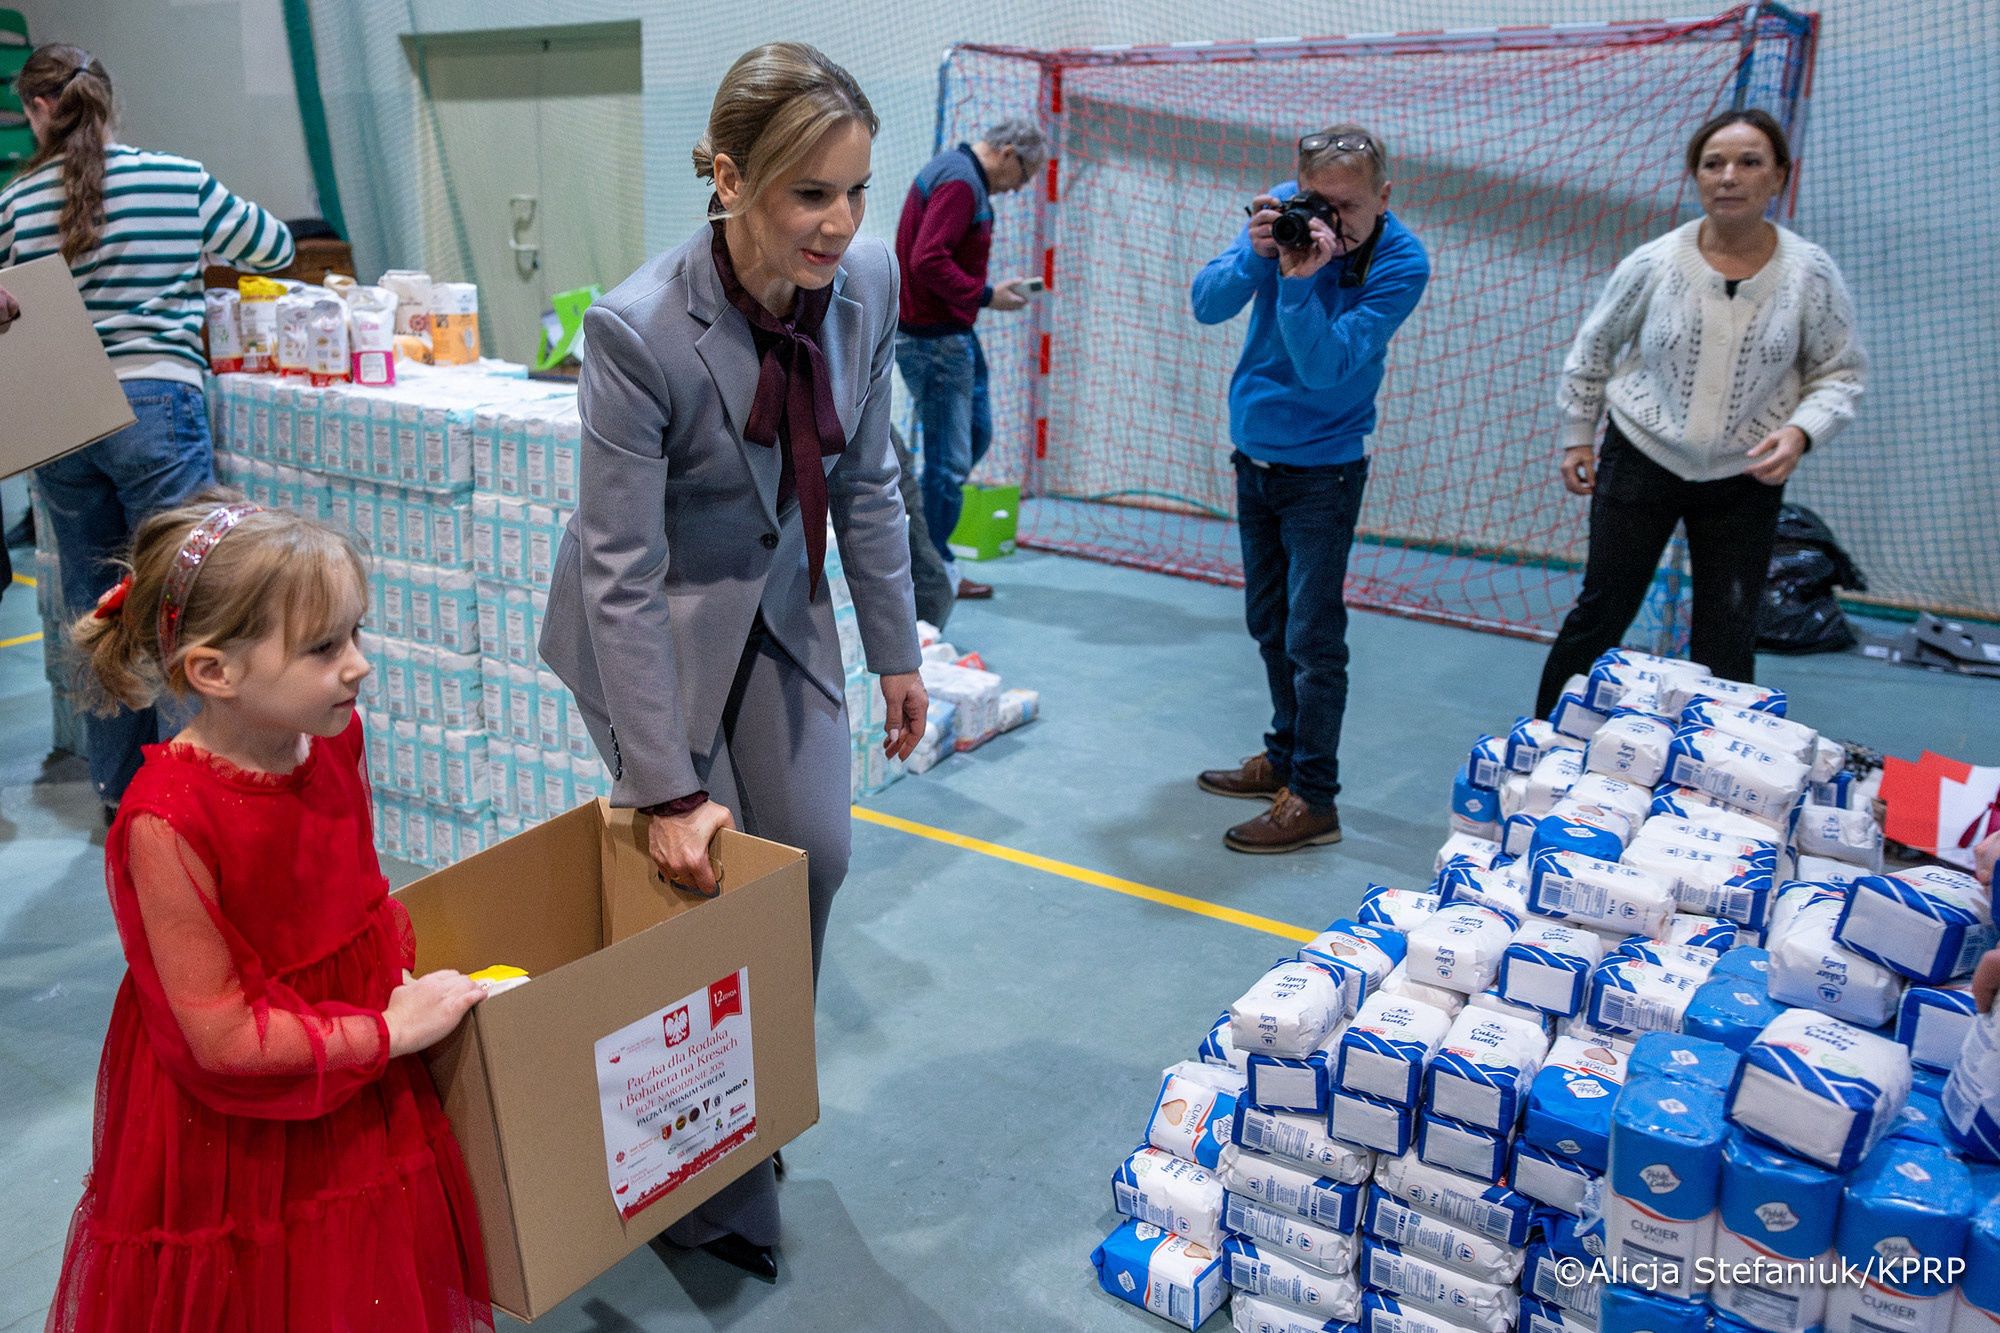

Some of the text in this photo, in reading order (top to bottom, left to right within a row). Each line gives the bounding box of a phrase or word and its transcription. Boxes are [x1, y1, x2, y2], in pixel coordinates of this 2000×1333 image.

[1471, 1028, 1506, 1041] Cukier
[626, 1073, 678, 1106] Bohatera
[680, 1063, 694, 1077] na
[697, 1038, 738, 1067] Kresach
[627, 1030, 728, 1091] Paczka dla Rodaka
[1575, 1059, 1616, 1077] CUKIER
[636, 1107, 663, 1127] PACZKA
[669, 1087, 699, 1109] POLSKIM
[699, 1071, 726, 1092] SERCEM
[725, 1084, 742, 1097] Netto
[1183, 1104, 1203, 1135] CUKIER
[1631, 1219, 1679, 1241] CUKIER
[1862, 1294, 1917, 1319] CUKIER
